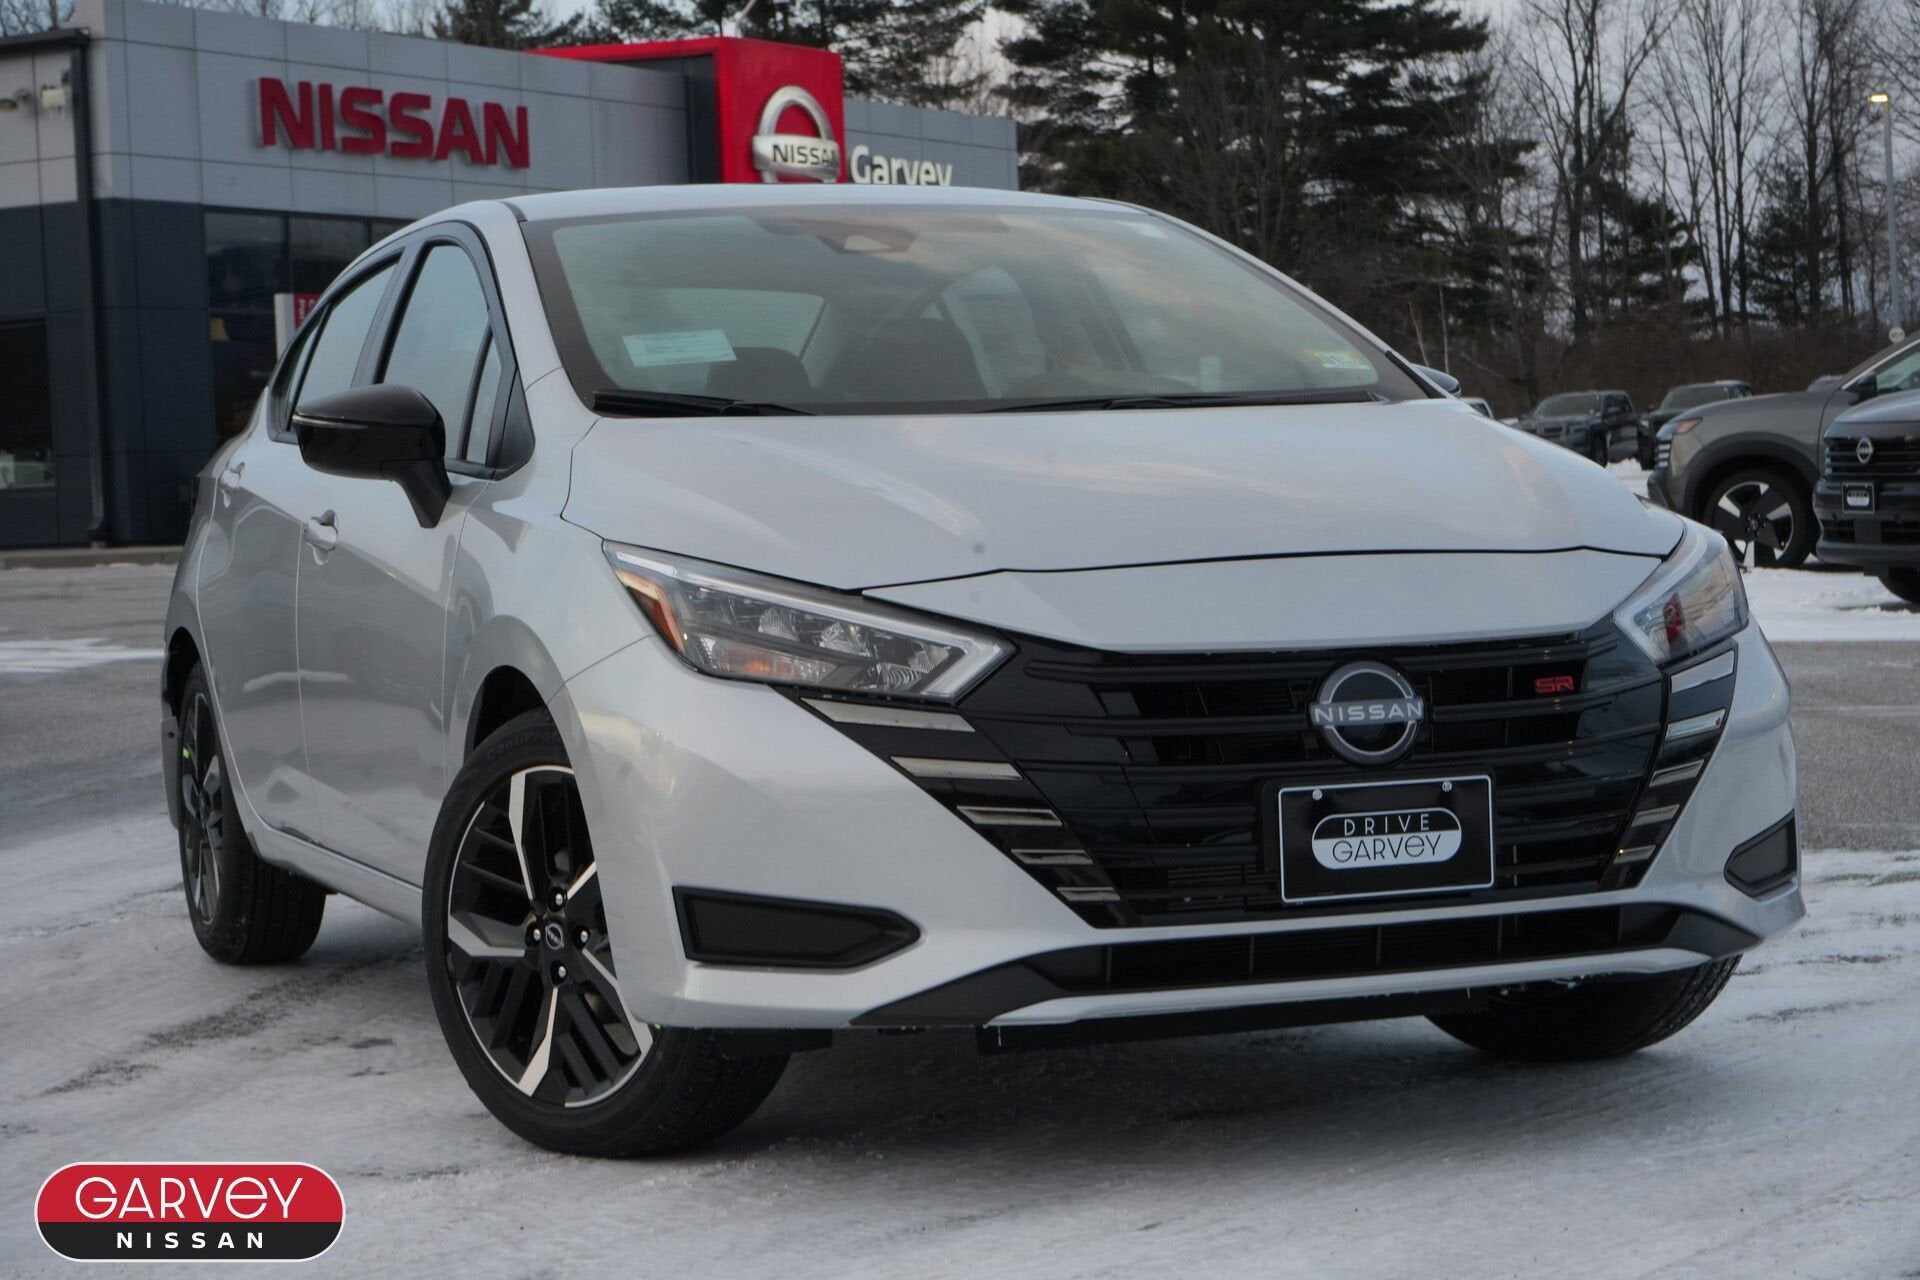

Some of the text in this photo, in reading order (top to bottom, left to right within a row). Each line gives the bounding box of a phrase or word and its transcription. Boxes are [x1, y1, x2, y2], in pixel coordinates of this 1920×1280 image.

[258, 77, 530, 168] NISSAN
[850, 144, 953, 185] Garvey
[1534, 675, 1575, 694] SR
[1313, 700, 1423, 723] NISSAN
[1343, 813, 1431, 838] DRIVE
